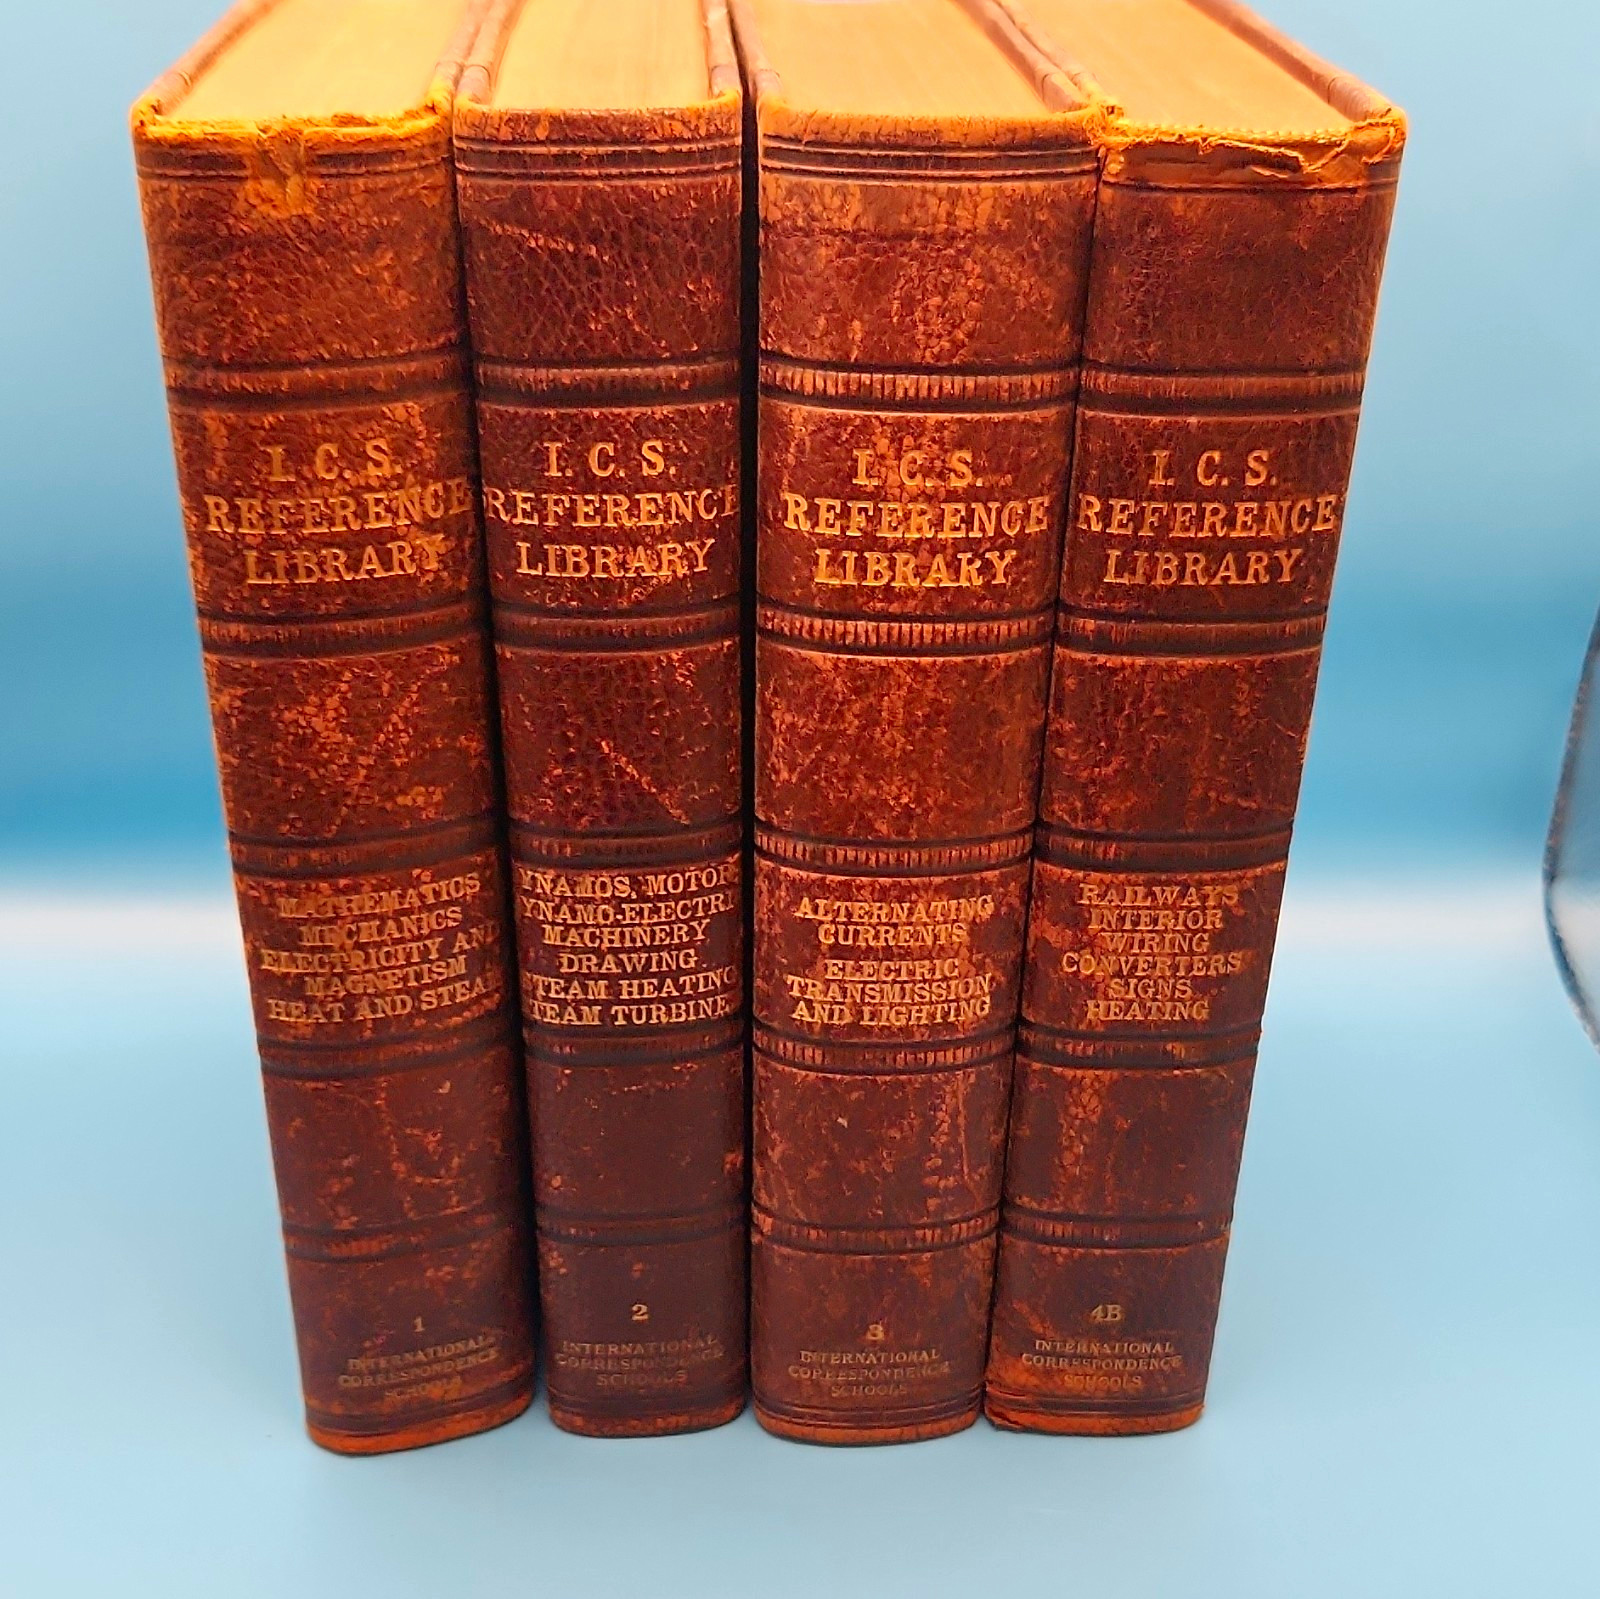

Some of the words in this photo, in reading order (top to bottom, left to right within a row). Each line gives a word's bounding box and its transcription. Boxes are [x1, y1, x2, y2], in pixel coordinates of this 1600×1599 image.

[543, 441, 573, 477] I.
[589, 441, 626, 477] C.
[641, 440, 677, 477] S.
[852, 448, 880, 486] I.
[900, 451, 935, 487] C.
[950, 450, 983, 487] S.
[1197, 450, 1229, 487] C.
[1245, 450, 1277, 487] S.
[204, 476, 473, 535] REFERENCE
[783, 492, 1050, 539] REFERENCE
[1077, 493, 1339, 538] REFERENCE
[243, 533, 445, 584] LIBRARY
[515, 538, 716, 578] LIBRARY
[814, 548, 1017, 587] LIBRARY
[1103, 549, 1302, 586] LIBRARY
[277, 872, 480, 919] MATHEMATICS
[794, 894, 995, 923] ALTERNATING
[1077, 883, 1239, 906] RAILWAYS
[299, 906, 463, 946] MECHANICS
[541, 918, 711, 948] MACHINERY
[817, 922, 967, 946] CURRENTS
[1088, 908, 1224, 930] INTERIOR
[260, 937, 444, 973] ELECTRICITY
[1101, 932, 1210, 953] WIRING
[303, 954, 467, 997] MAGNETISM
[557, 948, 698, 974] DRAWING
[824, 958, 959, 981] ELECTRIC
[1062, 952, 1243, 976] CONVERTERS
[786, 973, 992, 1003] TRANSMISSION
[1108, 979, 1192, 1000] SIGNS
[267, 998, 345, 1023] HEAT
[353, 994, 412, 1021] AND
[791, 1001, 850, 1025] AND
[859, 996, 991, 1026] LIGHTING
[1085, 1000, 1210, 1021] HEATING
[413, 1316, 425, 1333] 1
[631, 1304, 649, 1321] 2
[1090, 1304, 1123, 1322] 4B
[1035, 1339, 1176, 1355] INTERNATIONAL
